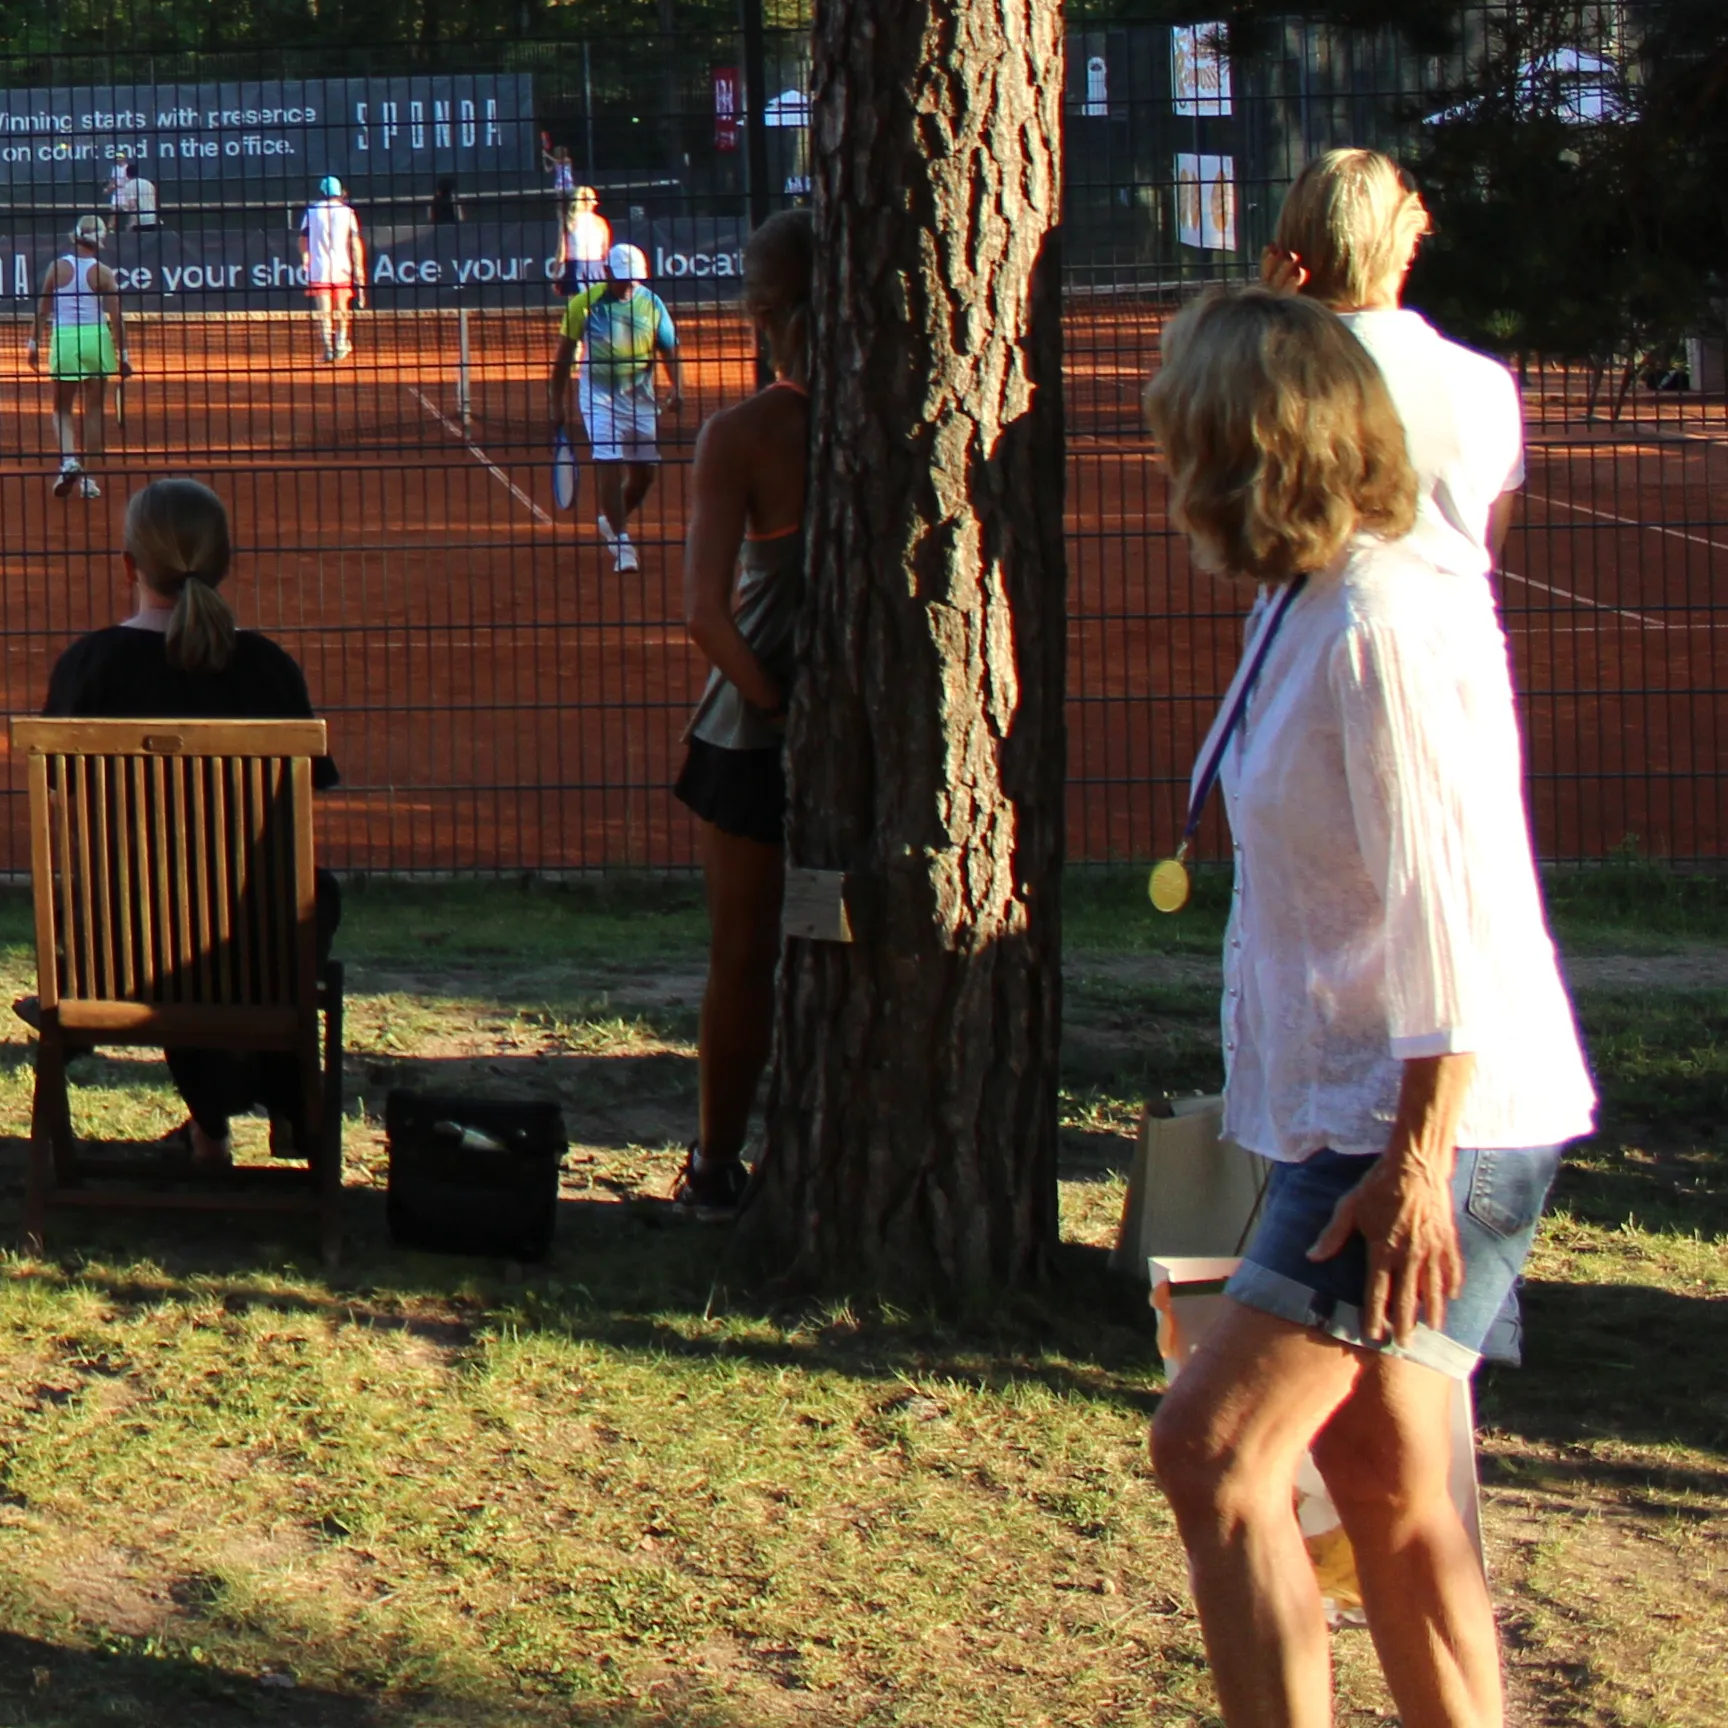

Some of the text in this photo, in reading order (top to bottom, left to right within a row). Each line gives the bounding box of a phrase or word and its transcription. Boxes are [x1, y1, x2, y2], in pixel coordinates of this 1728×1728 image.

[81, 110, 147, 129] starts
[156, 106, 202, 128] with
[207, 106, 317, 128] presence
[356, 99, 502, 150] SPONDA
[1, 146, 32, 162] on
[103, 139, 148, 160] and
[180, 137, 219, 158] the
[111, 264, 153, 290] ce
[161, 263, 243, 296] your
[252, 257, 310, 287] sho
[372, 254, 442, 284] Ace
[452, 256, 533, 290] your
